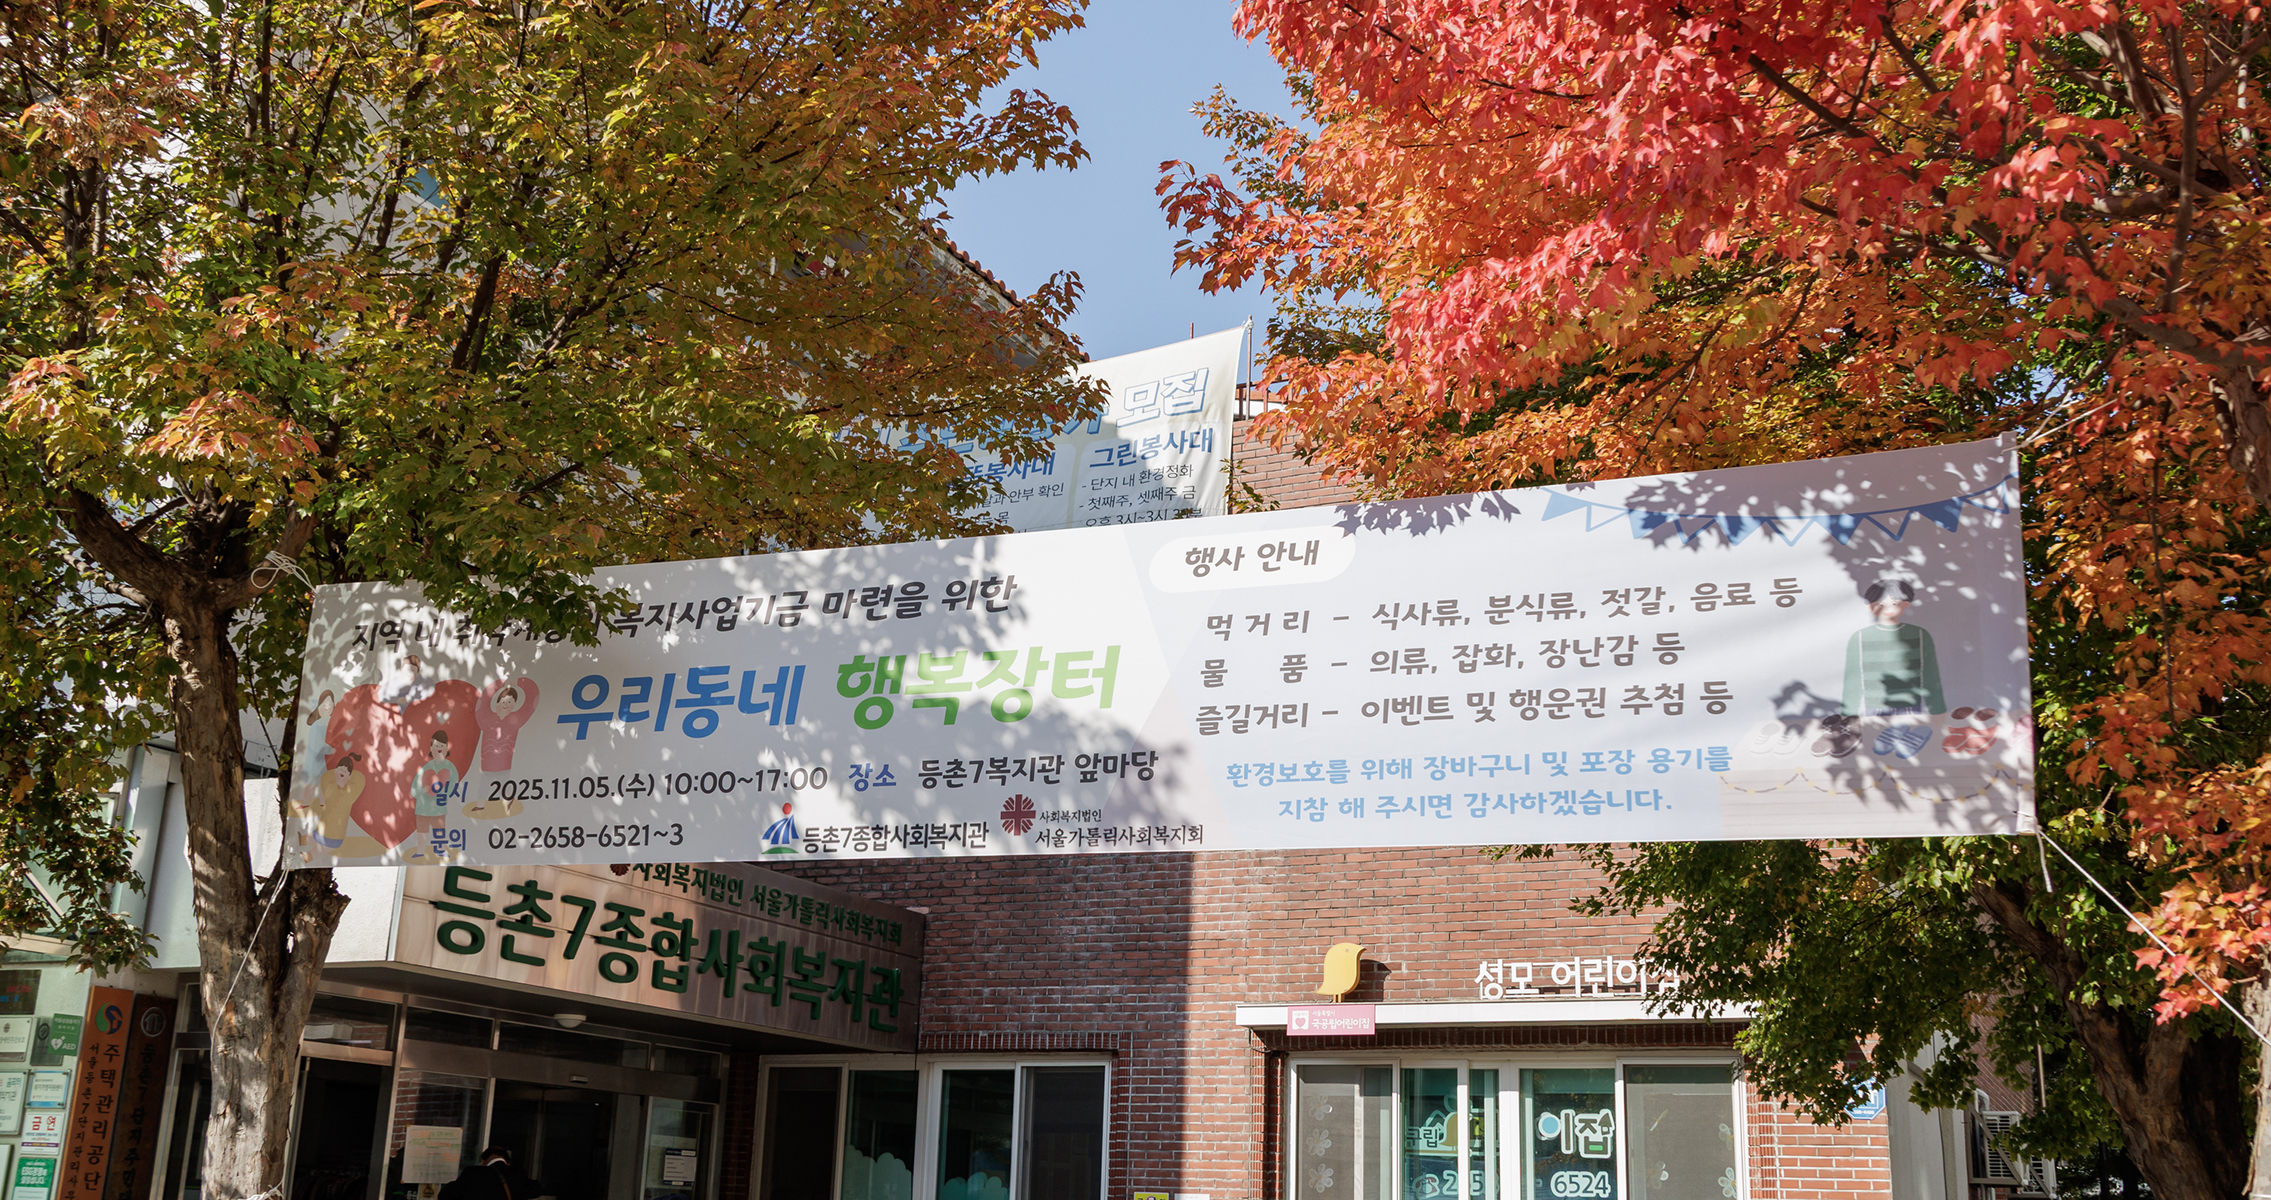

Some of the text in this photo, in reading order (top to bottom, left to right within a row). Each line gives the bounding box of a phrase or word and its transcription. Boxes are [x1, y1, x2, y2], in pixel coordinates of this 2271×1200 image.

[1116, 367, 1209, 428] 모집
[1089, 428, 1213, 467] 그린봉사대
[1009, 487, 1034, 503] 안부
[1038, 482, 1064, 498] 확인
[1087, 485, 1197, 511] 첫째주, 셋째주 금
[1091, 464, 1194, 491] 단지 내 환경정화
[1185, 539, 1320, 578] 행사 안내
[352, 618, 406, 652] 지역
[415, 616, 442, 648] 내
[613, 590, 809, 639] 복지사업기금
[822, 581, 928, 621] 마련을
[942, 575, 1017, 613] 위한
[1372, 599, 1471, 631] 식사류,
[1484, 592, 1586, 625] 분식류,
[1601, 586, 1676, 618] 젓갈,
[1690, 582, 1756, 612] 음료
[1769, 577, 1803, 608] 등
[1370, 647, 1438, 675] 의류,
[1452, 643, 1525, 674] 잡화,
[1538, 635, 1639, 669] 장난감
[1652, 632, 1685, 665] 등
[557, 644, 1121, 741] 우리동네 행복장터
[1195, 702, 1309, 736] 즐길거리
[1361, 695, 1454, 726] 이벤트
[1466, 691, 1496, 723] 및
[1509, 687, 1607, 721] 행운권
[1620, 683, 1686, 716] 추첨
[1700, 680, 1734, 715] 등
[430, 766, 827, 807] 일시 2025.11.05.(수) 10:00~17:00
[848, 751, 1158, 792] 장소 등촌7복지관 앞마당
[1226, 745, 1733, 788] 환경보호를 위해 장바구니 및 포장 용기를
[1039, 808, 1102, 823] 사회복지법인
[1278, 789, 1673, 822] 지참 해 주시면 감사하겠습니다.
[430, 823, 683, 854] 문의 02-2658-6521~3
[802, 821, 989, 854] 등촌7종합사회복지관
[1035, 824, 1204, 847] 서울가톨릭사회복지회
[633, 863, 903, 946] 사회복지법인 서울가톨릭사회복지회
[434, 865, 904, 1034] 등촌7종합사회복지관
[1474, 958, 1540, 1000] 성모
[1311, 1018, 1370, 1030] 국공립어린이집
[62, 1042, 76, 1050] AED
[83, 1044, 120, 1191] 주택관리공단
